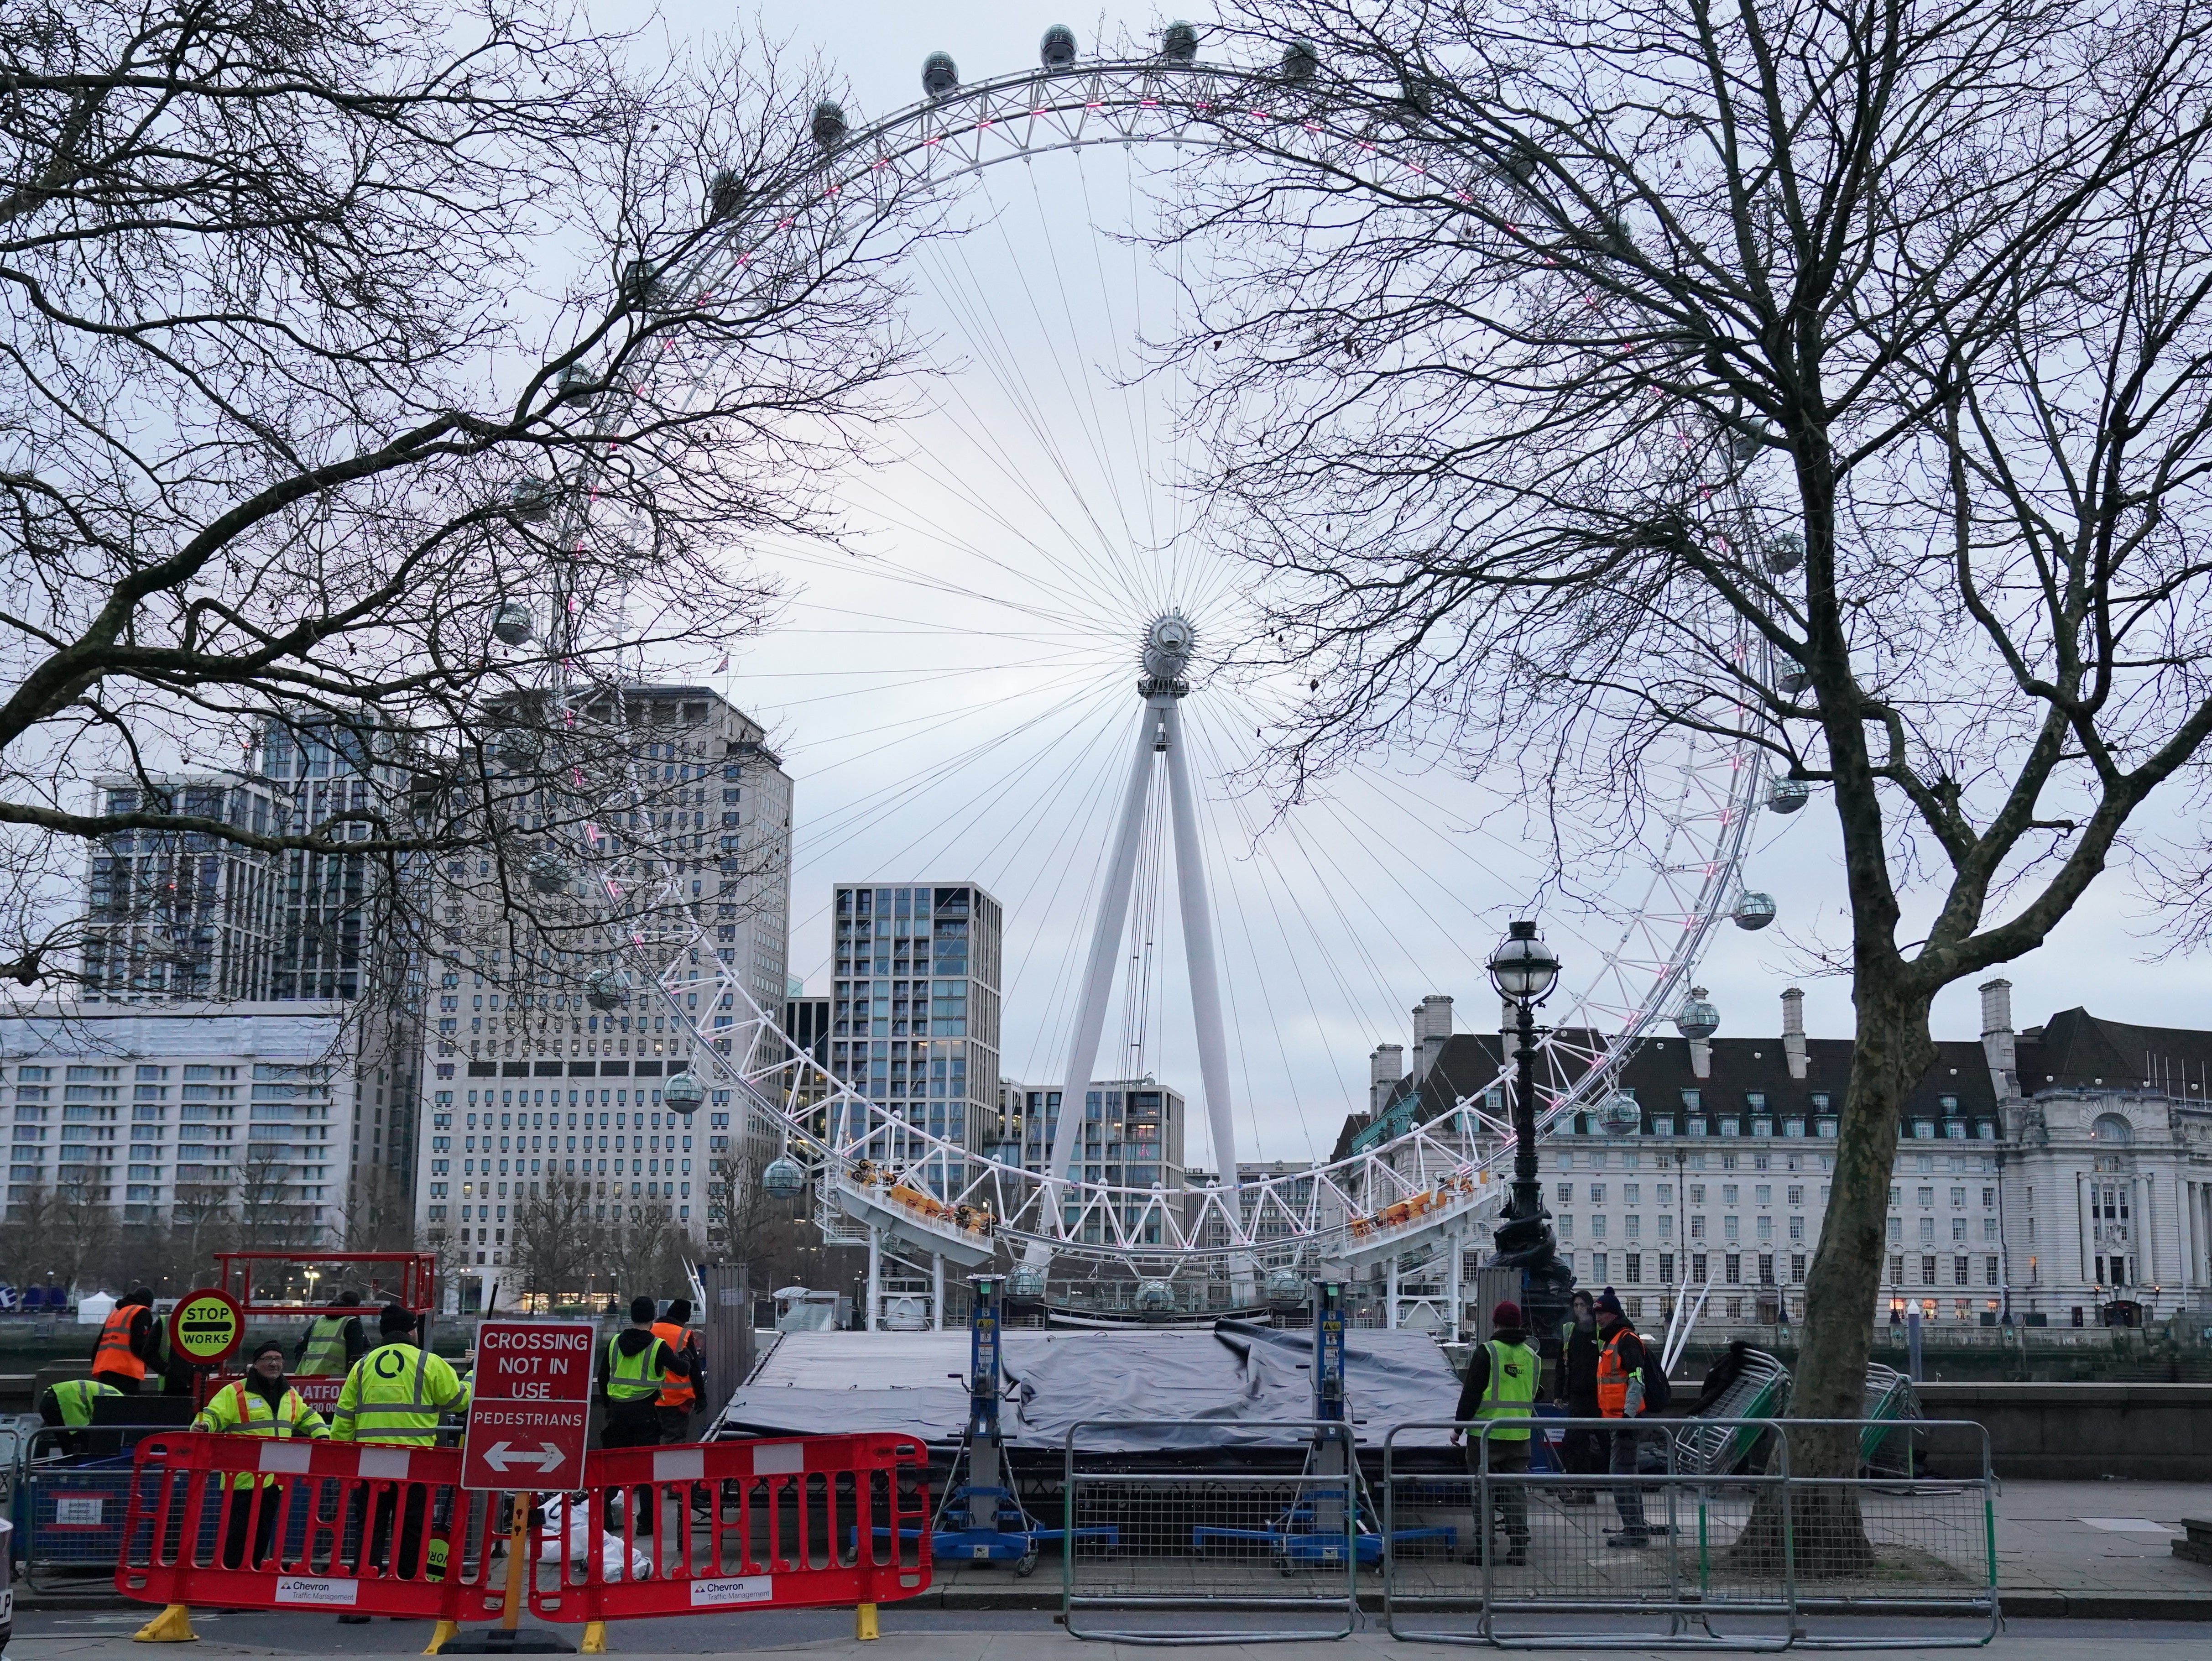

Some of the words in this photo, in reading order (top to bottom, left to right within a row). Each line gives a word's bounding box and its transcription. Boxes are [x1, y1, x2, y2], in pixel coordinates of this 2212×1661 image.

[186, 1307, 229, 1320] STOP
[184, 1334, 229, 1344] WORKS
[484, 1332, 588, 1351] CROSSING
[498, 1357, 542, 1374] NOT
[549, 1358, 569, 1374] IN
[296, 1385, 344, 1399] ATFO
[511, 1382, 551, 1399] USE
[474, 1411, 582, 1426] PEDESTRIANS
[293, 1581, 329, 1591] Chevron
[707, 1583, 743, 1592] Chevron
[313, 1593, 354, 1601] Management
[728, 1591, 770, 1599] Management
